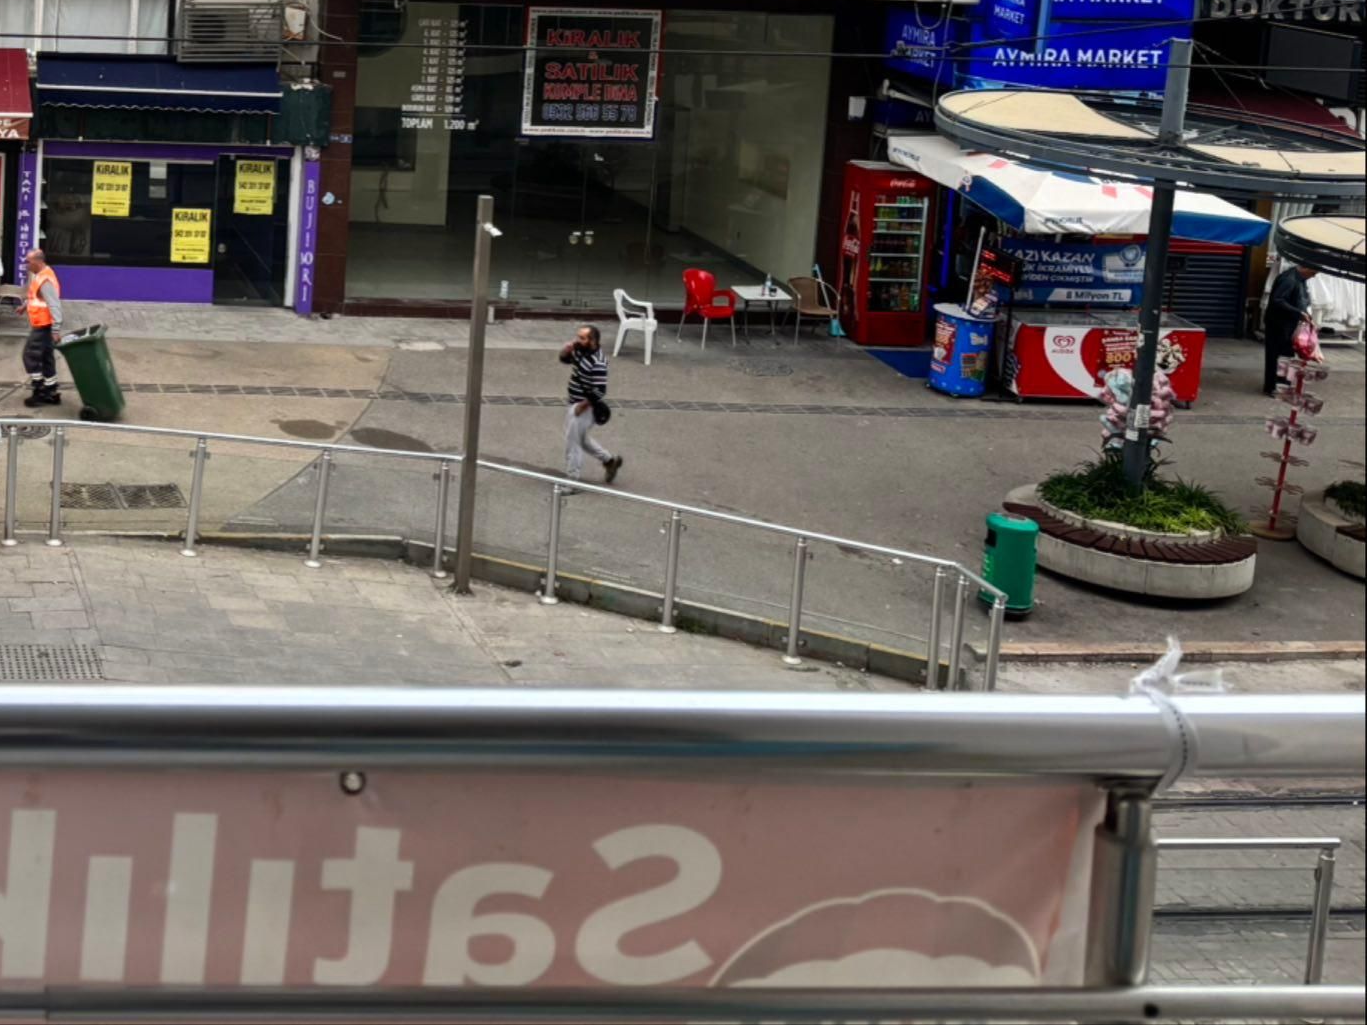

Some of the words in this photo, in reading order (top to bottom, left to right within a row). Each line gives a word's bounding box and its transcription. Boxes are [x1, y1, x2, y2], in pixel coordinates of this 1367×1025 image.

[1077, 48, 1163, 69] MARKET
[1074, 291, 1110, 301] Milyon
[1112, 292, 1124, 301] TL
